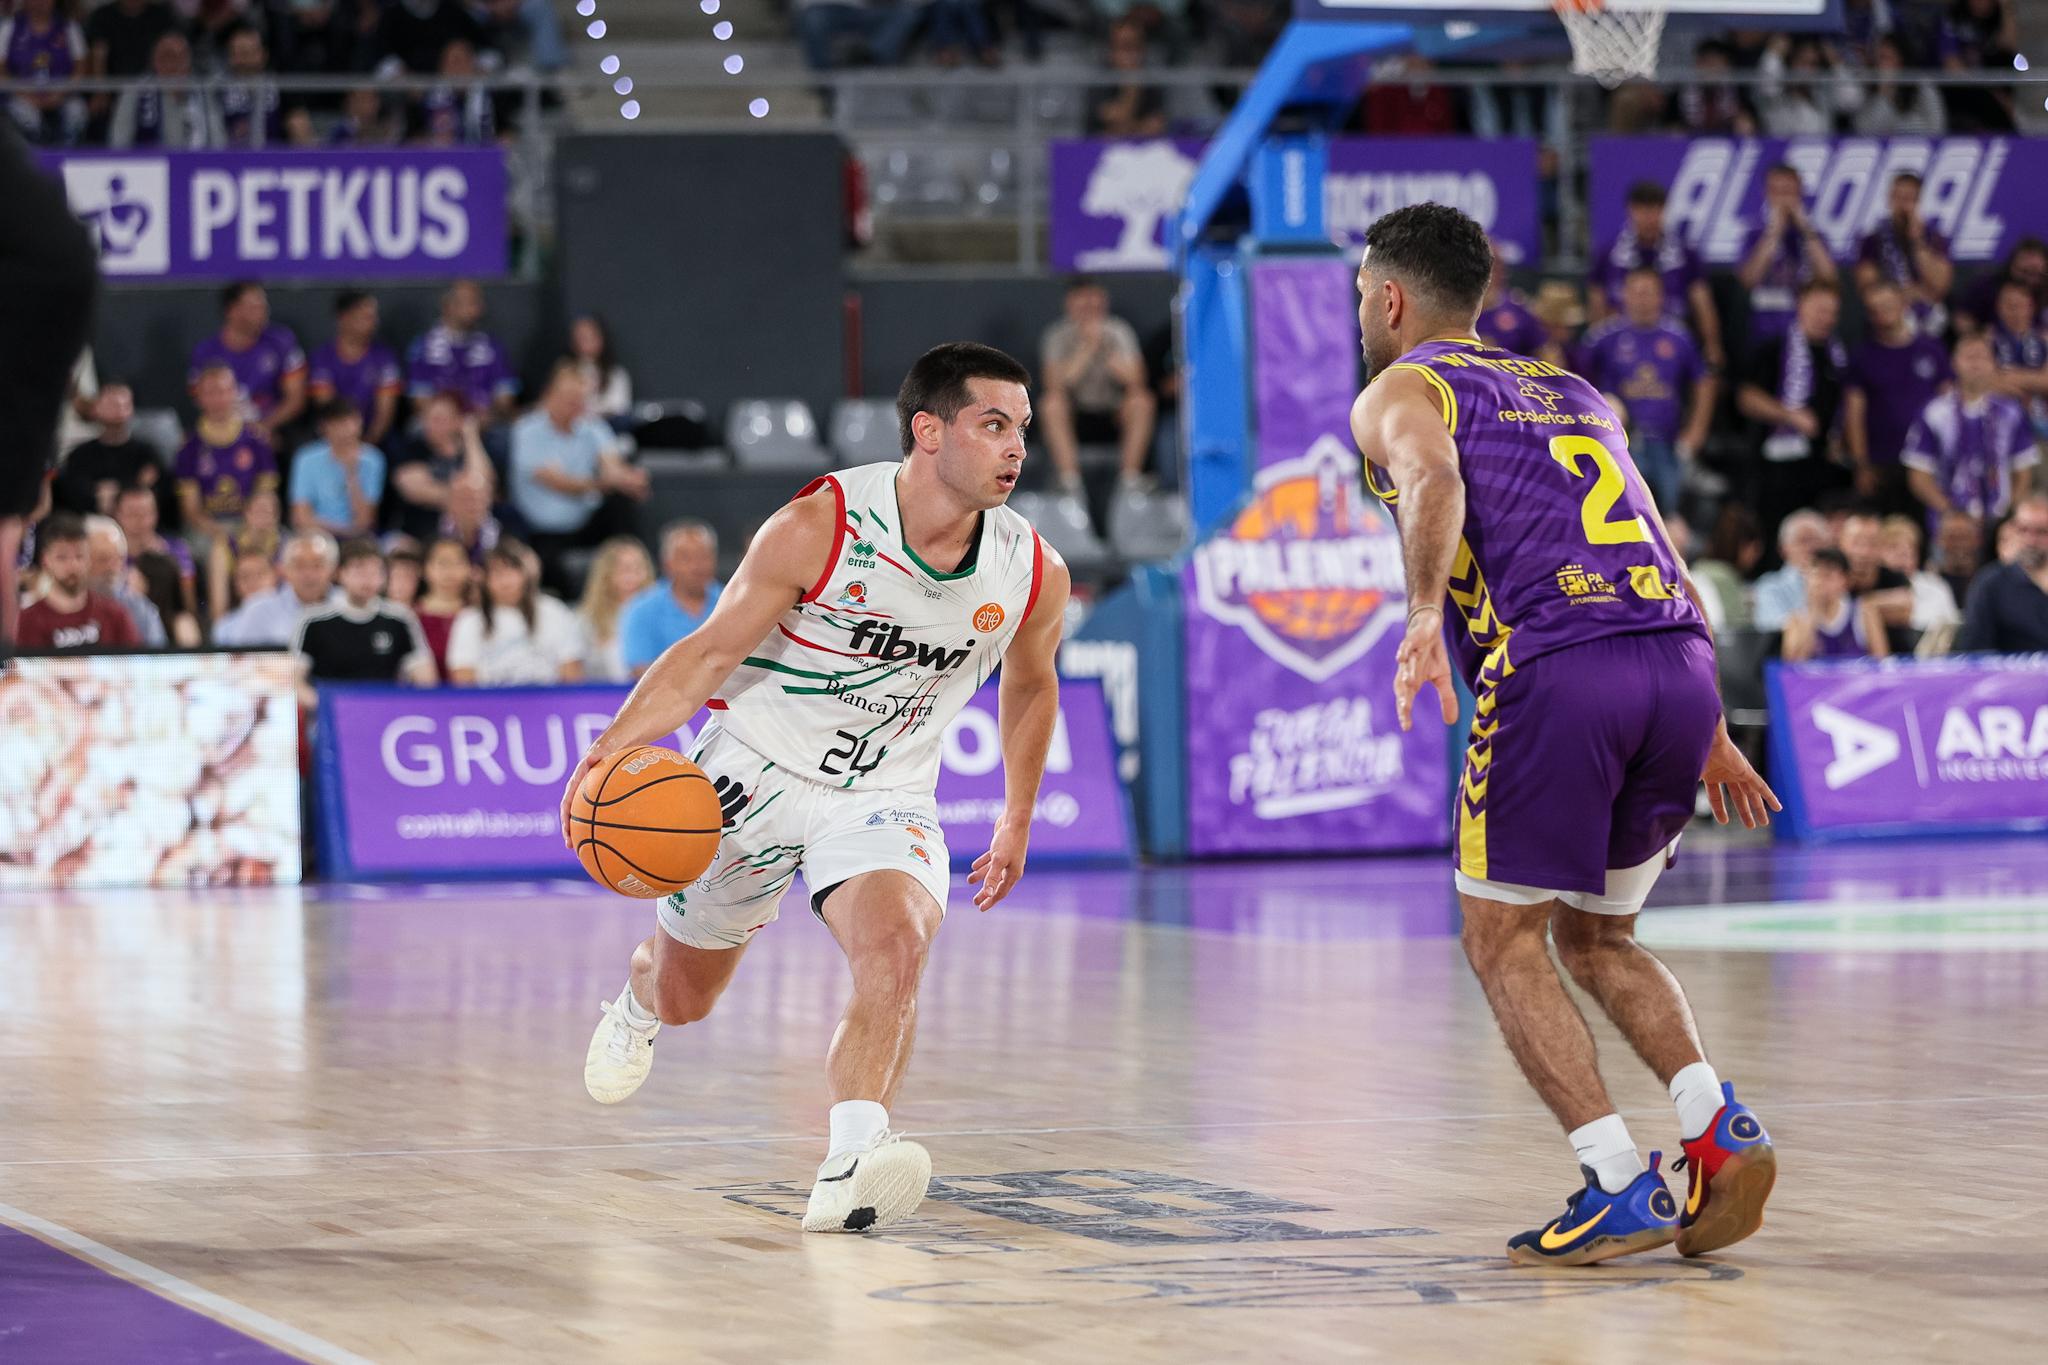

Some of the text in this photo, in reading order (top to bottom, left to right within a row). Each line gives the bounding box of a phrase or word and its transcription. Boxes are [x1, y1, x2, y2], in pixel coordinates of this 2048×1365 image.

[191, 168, 468, 260] PETKUS
[1666, 139, 1760, 261] AL
[1431, 353, 1585, 380] WINTERIN
[1498, 410, 1615, 431] recoletas salud
[1549, 436, 1653, 544] 2
[848, 557, 875, 569] errea
[1211, 538, 1403, 594] PALENCI
[924, 589, 942, 600] 1982
[849, 620, 976, 671] fibwi
[909, 671, 921, 681] TV
[826, 679, 887, 715] Blanca
[819, 730, 886, 777] 24
[667, 896, 686, 917] errea
